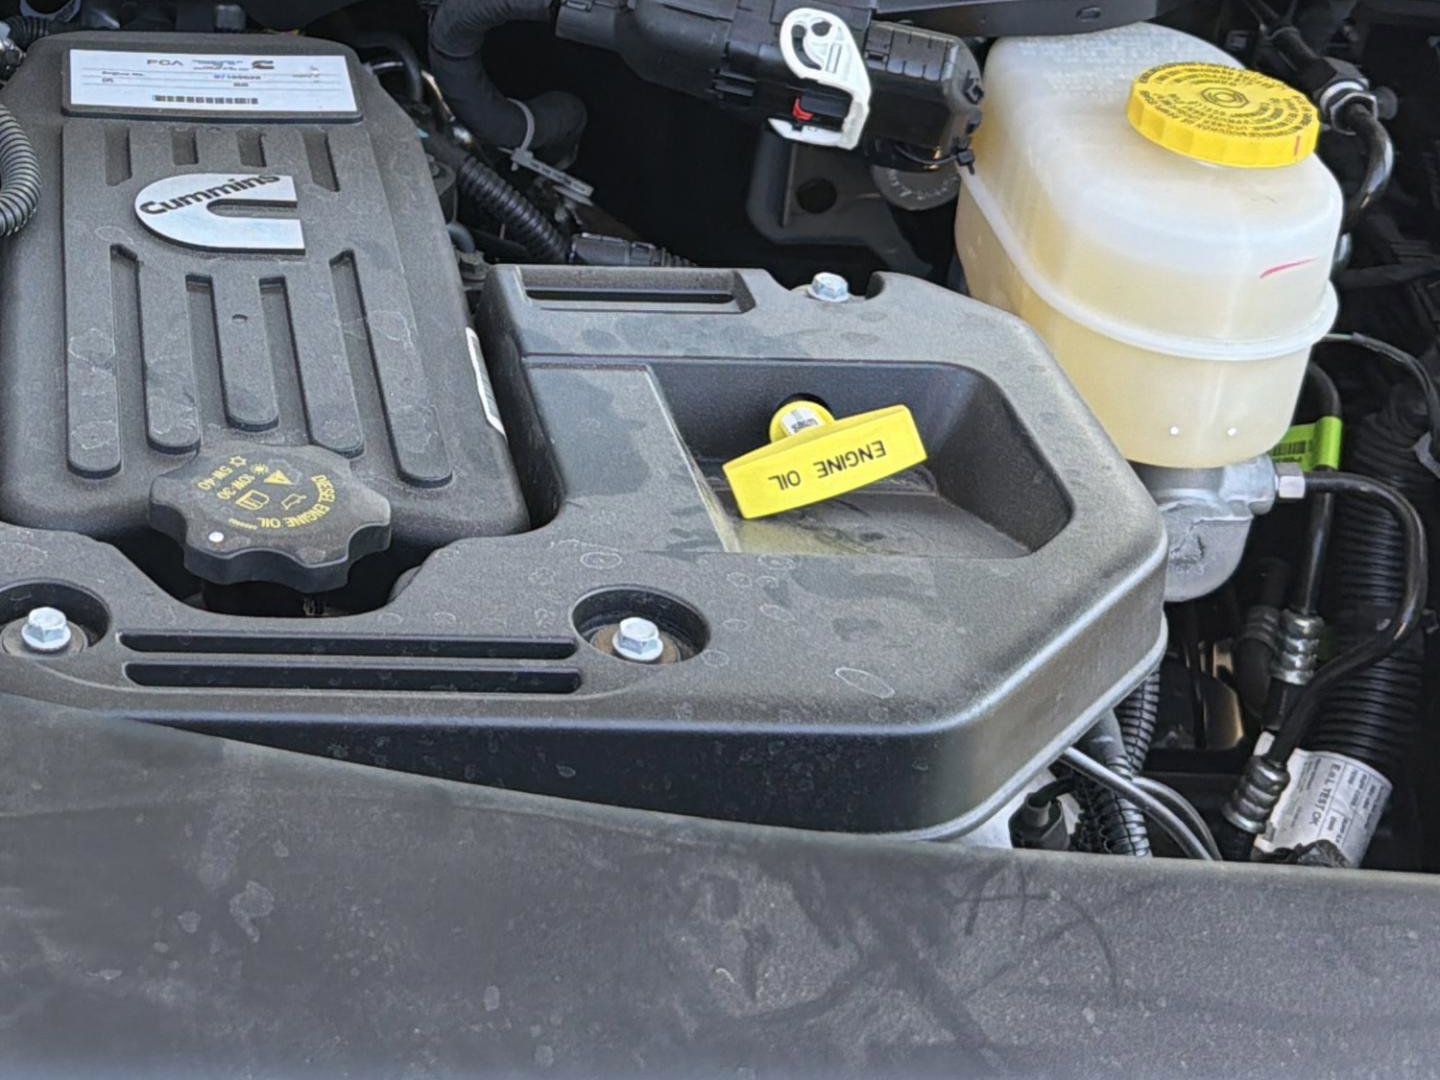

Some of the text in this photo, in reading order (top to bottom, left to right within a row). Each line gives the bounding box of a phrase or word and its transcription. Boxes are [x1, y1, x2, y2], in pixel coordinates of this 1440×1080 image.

[146, 58, 184, 67] FCA
[139, 174, 281, 215] Cummins
[198, 465, 233, 490] 5W-40
[767, 439, 887, 491] ENGINE OIL
[216, 473, 256, 500] 10W-30
[256, 517, 281, 529] OIL
[283, 503, 331, 528] ENGINE
[1314, 788, 1332, 811] TEST
[1309, 811, 1322, 826] OK
